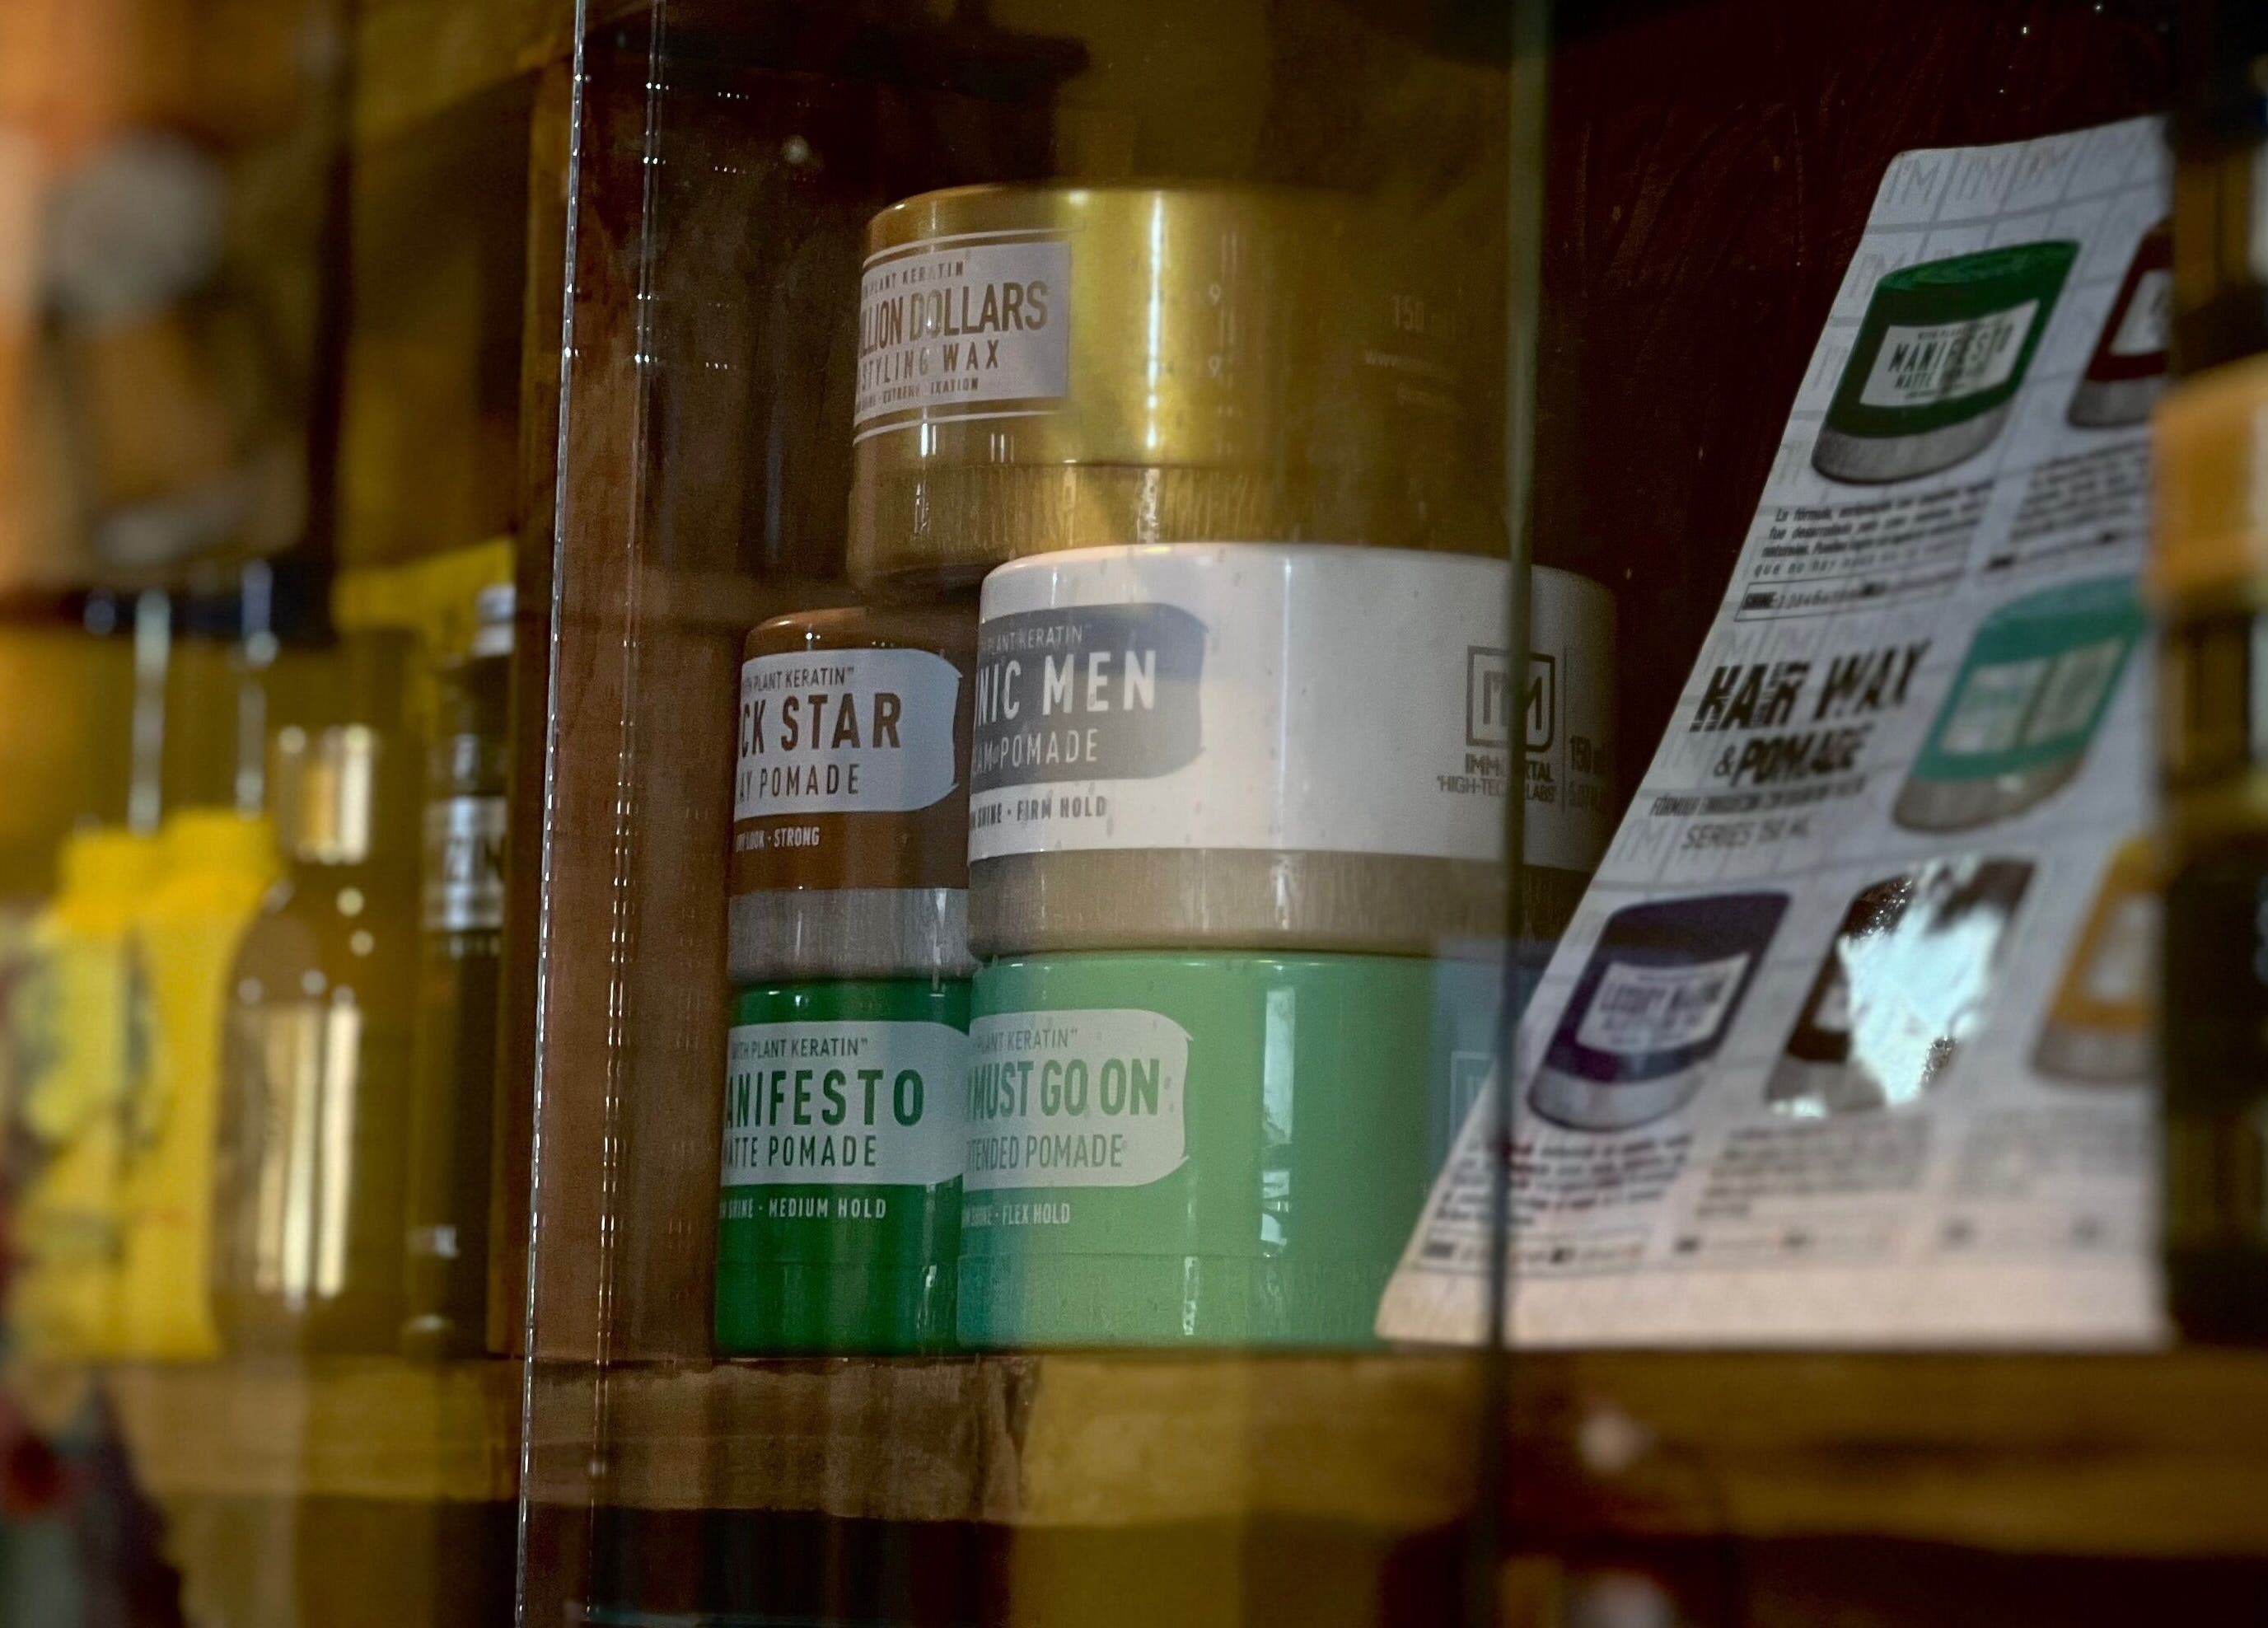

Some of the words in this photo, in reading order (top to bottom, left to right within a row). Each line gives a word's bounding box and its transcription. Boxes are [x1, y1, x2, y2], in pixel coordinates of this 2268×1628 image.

[910, 280, 1049, 342] DOLLARS
[942, 339, 1000, 374] WAX
[928, 377, 979, 395] IXATION
[1042, 649, 1157, 716] MEN
[780, 692, 901, 752] STAR
[1000, 727, 1099, 769] POMADE
[759, 763, 861, 800] POMADE
[1017, 796, 1053, 821] FIRM
[1059, 795, 1108, 819] HOLD
[773, 826, 821, 849] STRONG
[751, 1038, 787, 1060] PLANT
[1040, 1058, 1089, 1117] GO
[1099, 1057, 1160, 1116] ON
[767, 1134, 877, 1167] POMADE
[1026, 1133, 1124, 1169] POMADE
[768, 1196, 829, 1220] MEDIUM
[837, 1198, 887, 1220] HOLD
[1002, 1203, 1030, 1226] FLEX
[1032, 1202, 1071, 1225] HOLD
